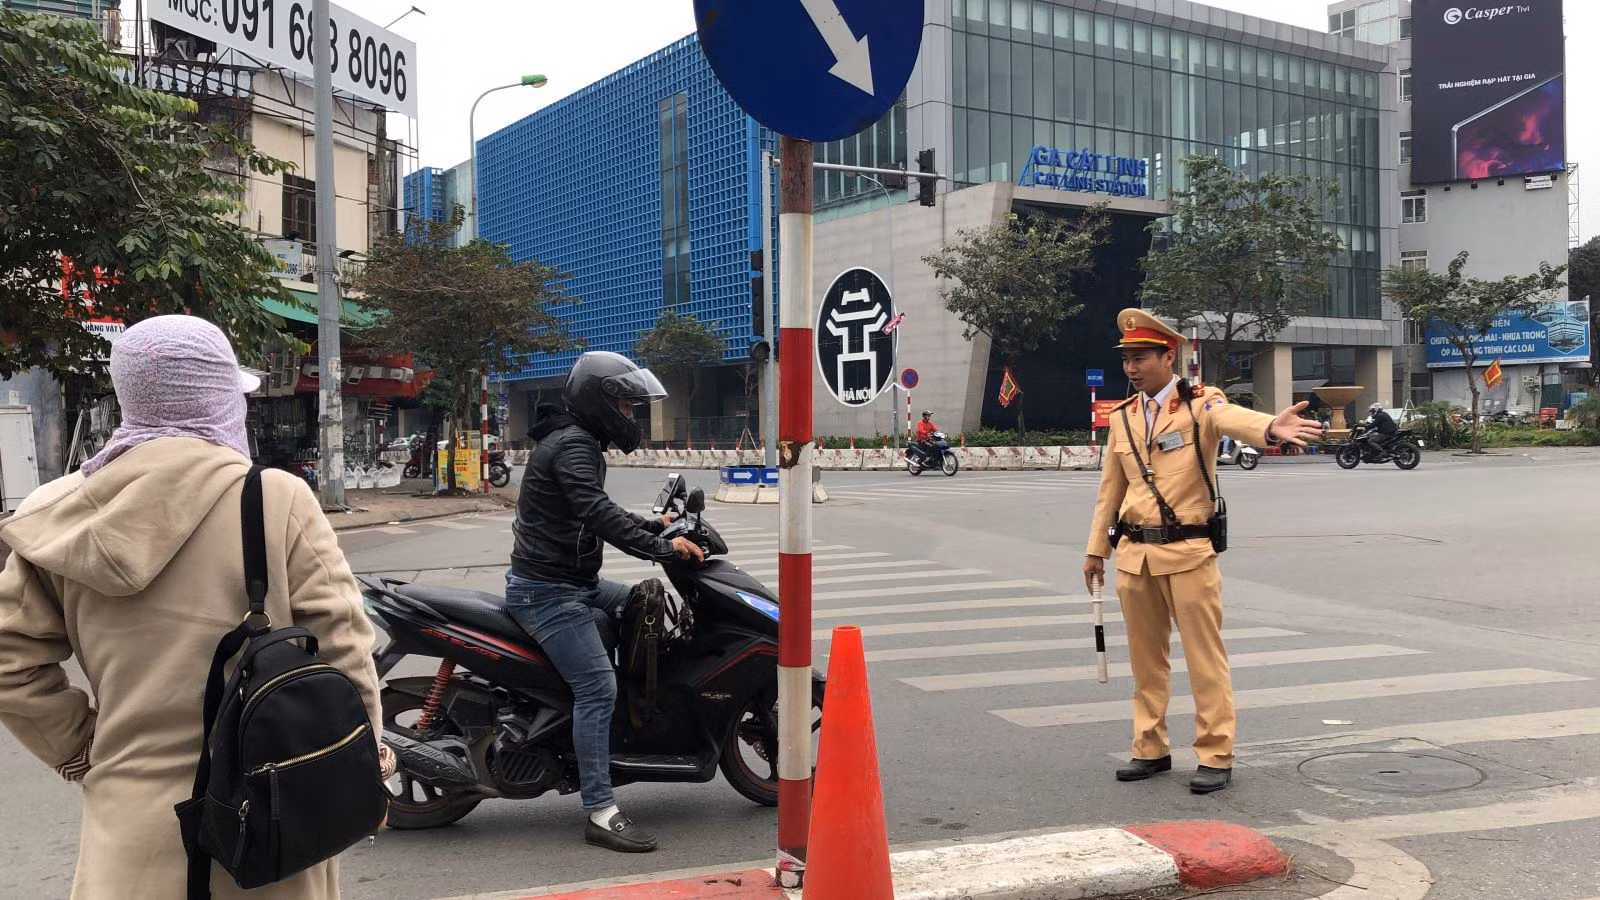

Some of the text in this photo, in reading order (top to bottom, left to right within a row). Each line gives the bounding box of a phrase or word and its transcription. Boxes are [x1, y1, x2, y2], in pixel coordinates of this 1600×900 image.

[1464, 5, 1514, 20] Casper
[221, 0, 274, 49] 091
[348, 28, 407, 102] 8096
[1454, 78, 1481, 88] NGHIỆM
[1482, 77, 1497, 86] RẠP
[1497, 74, 1511, 83] HÁT
[1511, 74, 1523, 82] TẠI
[1523, 72, 1536, 80] GIA
[1033, 146, 1147, 178] GA CÁT LINH
[1094, 178, 1147, 197] STATION
[843, 386, 871, 402] HÀ NỘI
